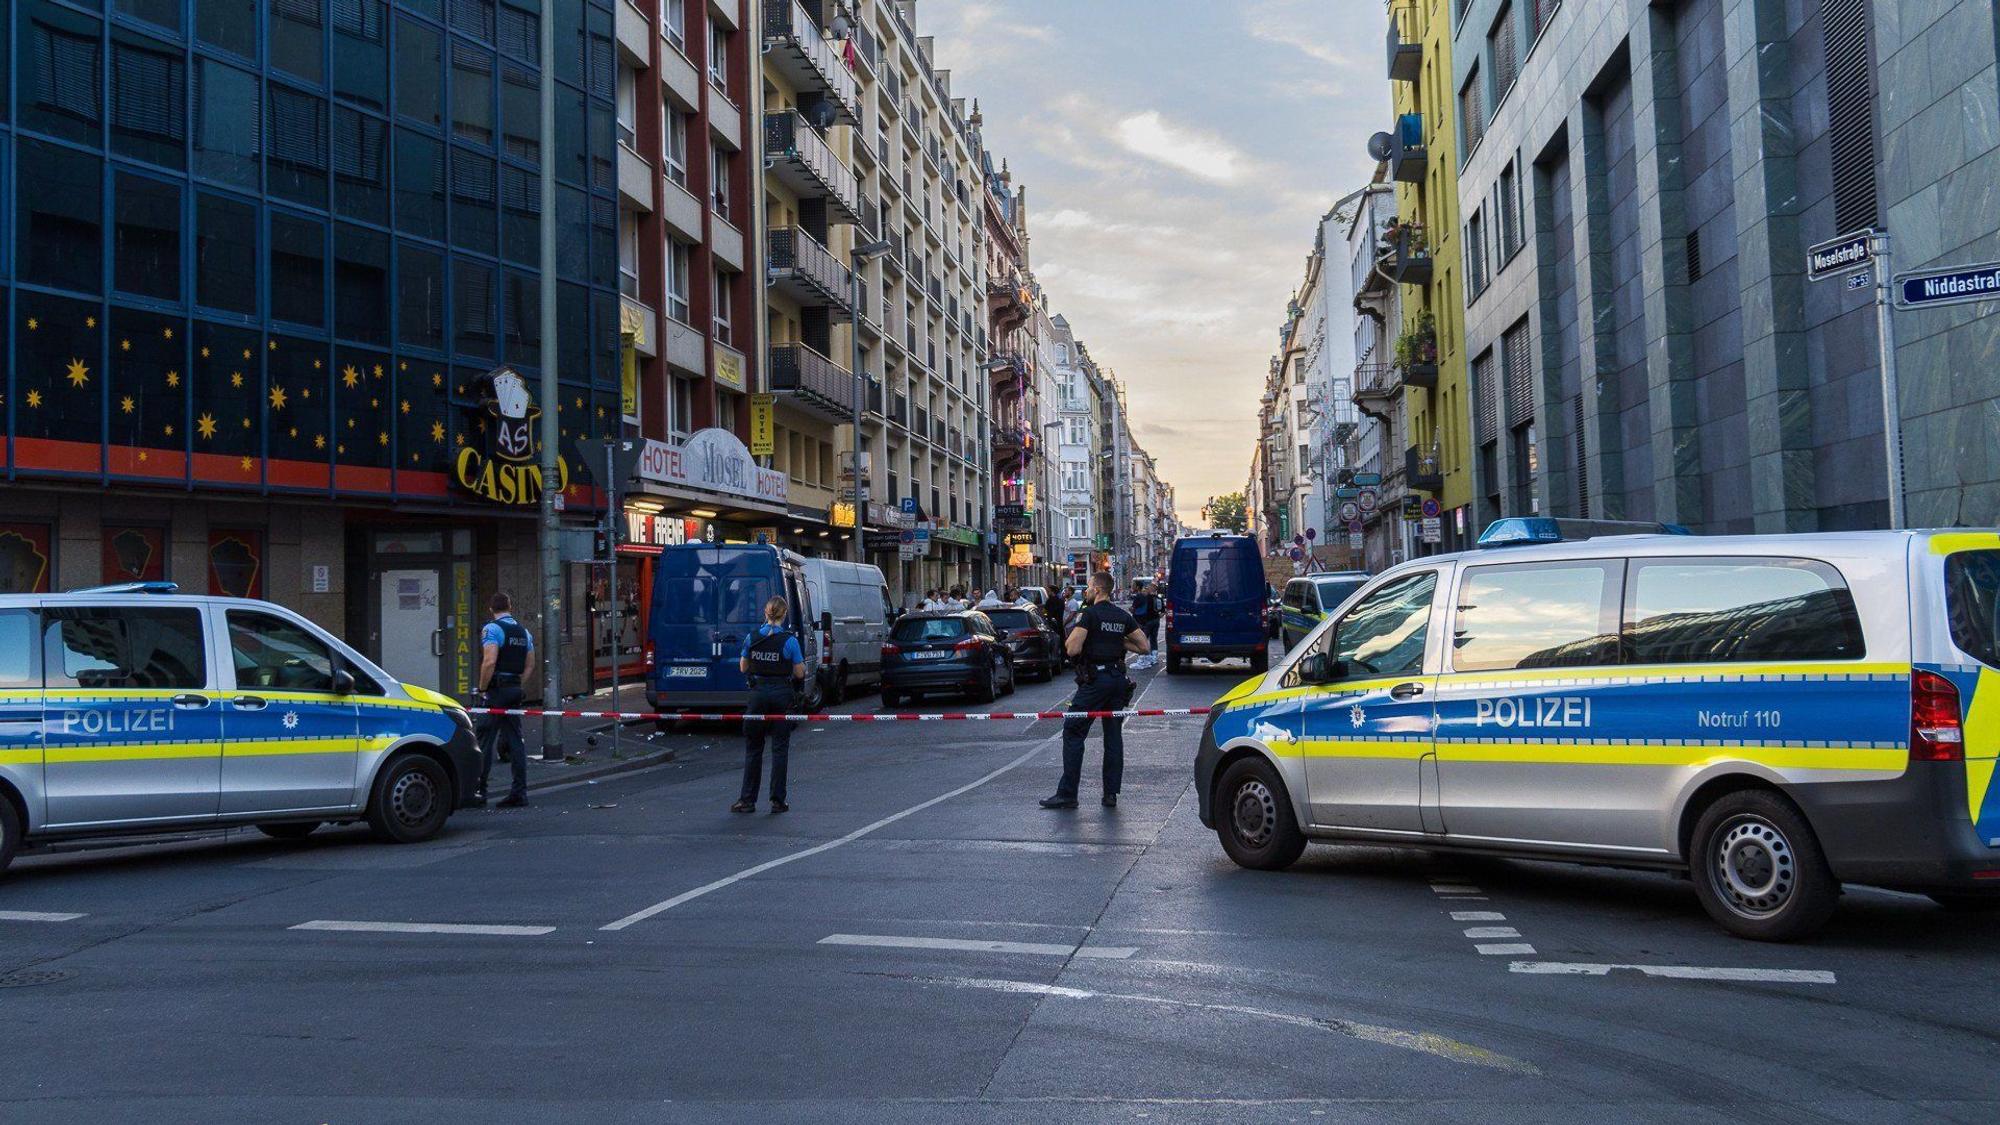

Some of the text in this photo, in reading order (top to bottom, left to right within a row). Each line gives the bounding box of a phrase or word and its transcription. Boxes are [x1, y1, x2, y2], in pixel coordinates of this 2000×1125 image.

[1814, 243, 1865, 270] Moselstraße
[498, 421, 529, 453] AS
[643, 446, 686, 479] HOTEL
[702, 440, 747, 489] MOSEL
[757, 471, 787, 498] HOTEL
[904, 500, 913, 511] P
[457, 566, 469, 694] SPIELHALLE
[1101, 622, 1125, 633] POLIZEI
[751, 650, 780, 662] POLIZEI
[63, 708, 175, 733] POLIZEI
[1476, 697, 1591, 727] POLIZEI
[1698, 710, 1781, 727] Notruf 110
